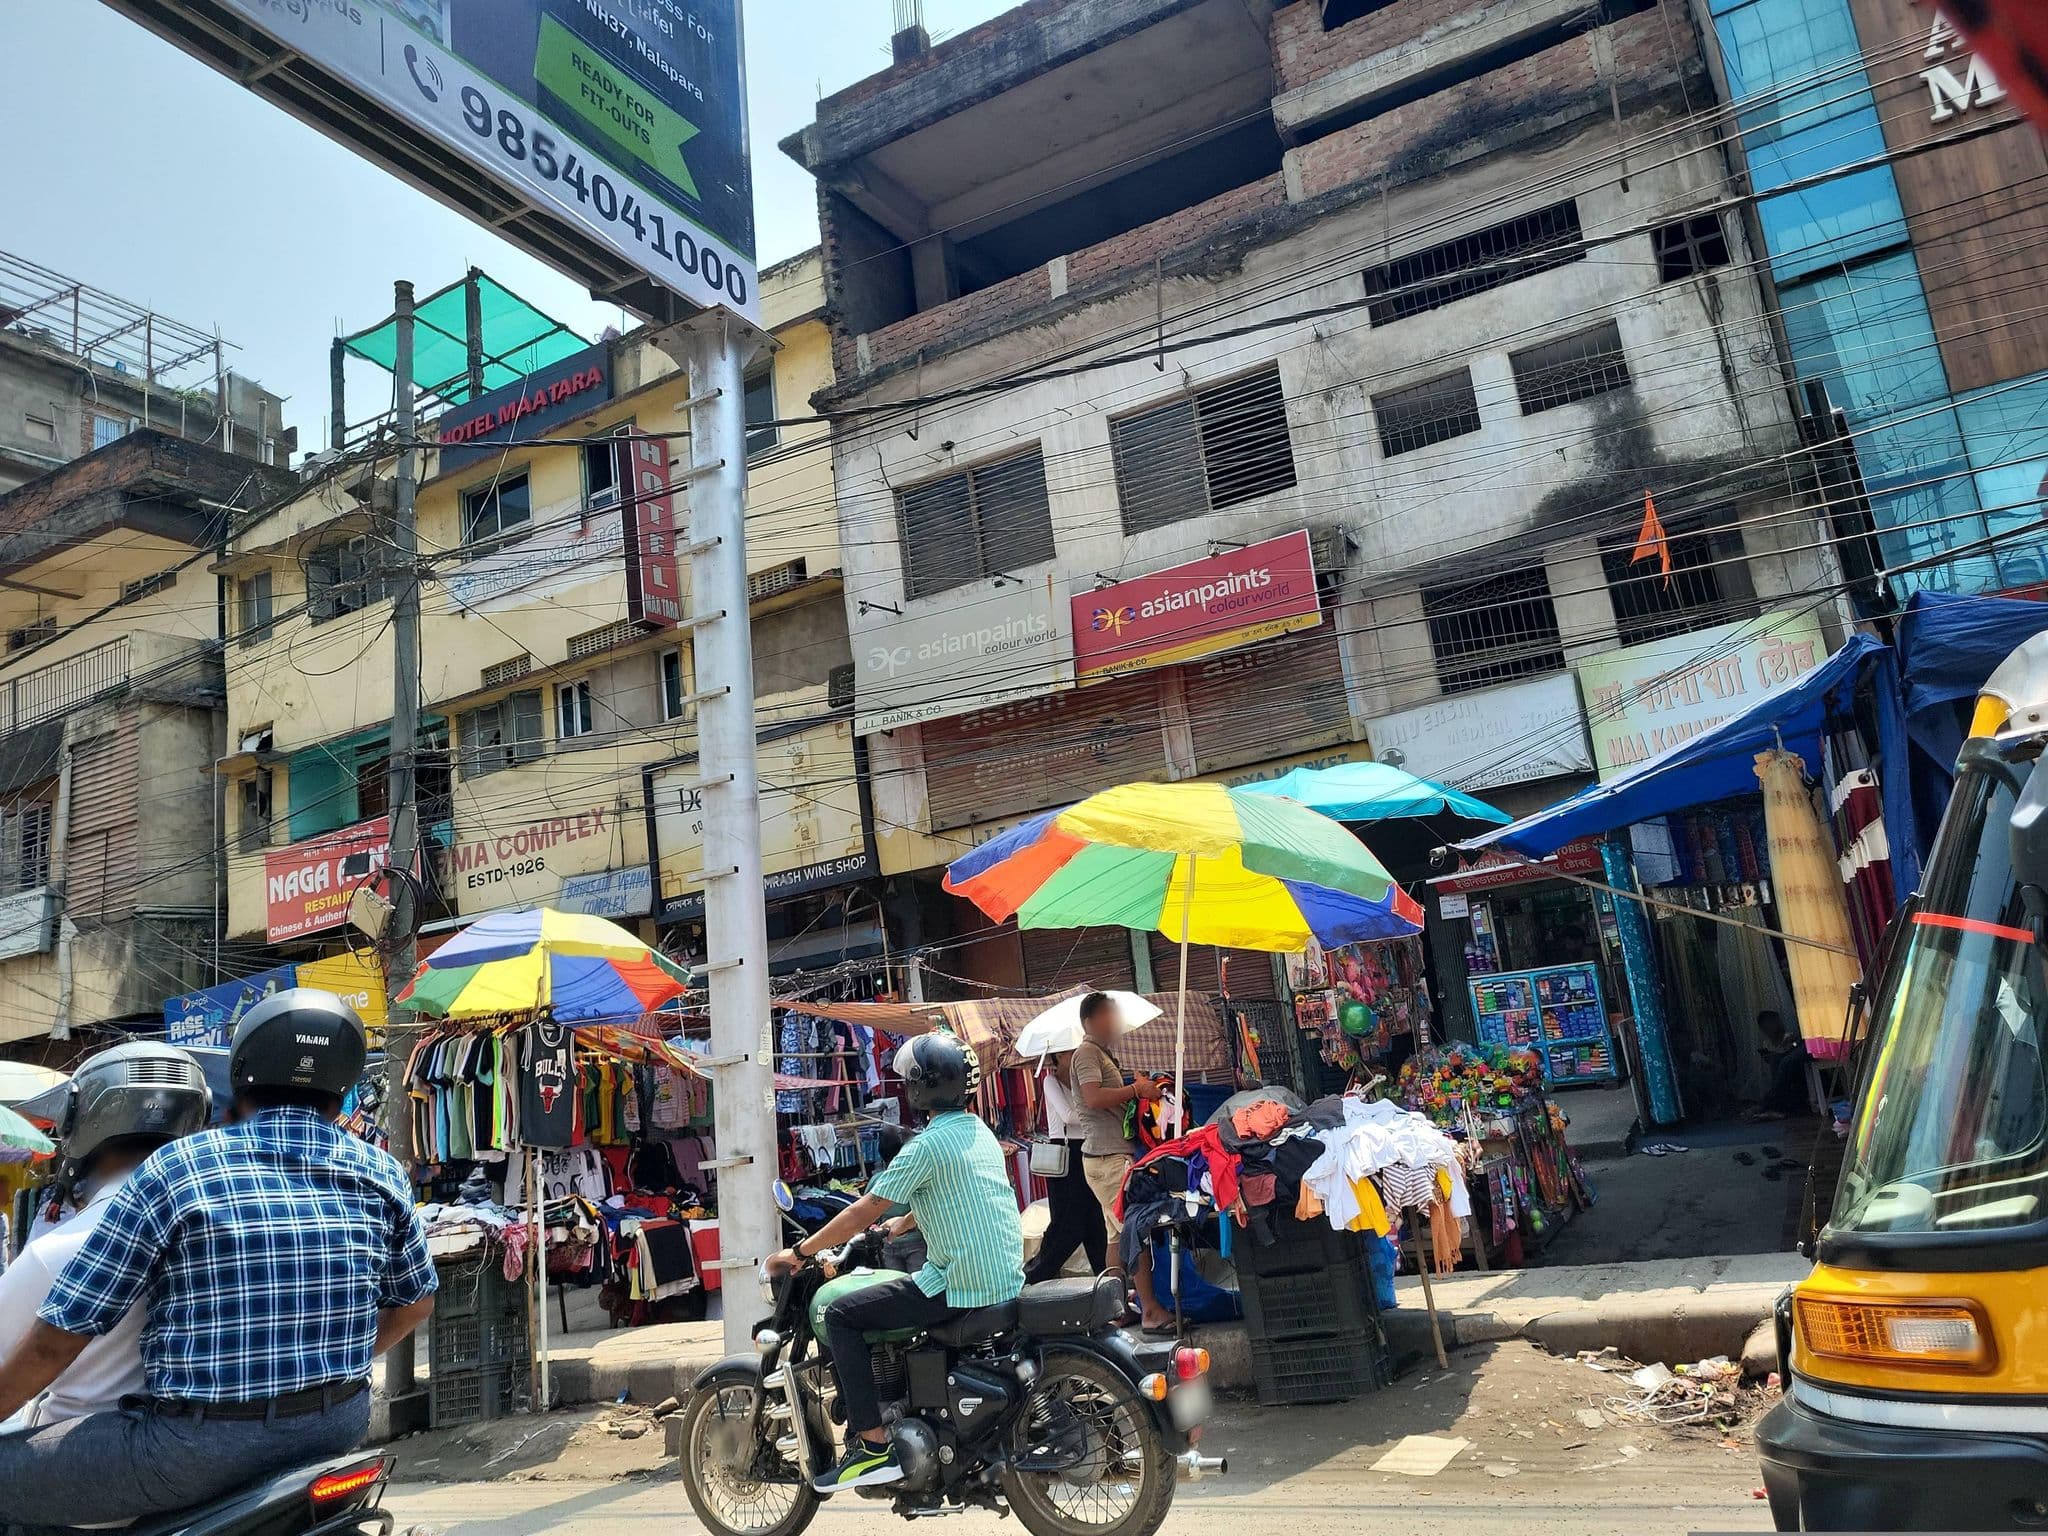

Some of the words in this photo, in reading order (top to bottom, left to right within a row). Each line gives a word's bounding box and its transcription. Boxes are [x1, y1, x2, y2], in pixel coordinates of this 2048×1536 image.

[635, 35, 704, 102] Nalapara
[571, 51, 623, 100] READY
[625, 94, 655, 127] FOR
[580, 83, 651, 145] FIT-OUTS
[459, 85, 748, 307] 9854041000
[439, 413, 496, 444] HOTEL
[498, 393, 549, 426] MAA
[548, 366, 604, 400] TARA
[639, 440, 670, 590] HOTEL
[661, 598, 681, 622] TARA
[1140, 566, 1272, 618] asianpaints
[917, 611, 1049, 661] asianpaints
[984, 637, 1022, 656] colour
[1024, 627, 1058, 646] world
[881, 711, 914, 727] BANIK
[1606, 733, 1651, 769] MAA
[496, 805, 607, 862] COMPLEX
[269, 860, 331, 905] NAGA
[467, 856, 546, 889] ESTD-1926
[803, 862, 835, 882] WINE
[835, 854, 868, 874] SHOP
[269, 920, 303, 938] Chinese
[304, 917, 313, 928] &
[170, 1015, 205, 1041] RISE
[295, 1033, 330, 1046] YAMAHA
[534, 1058, 567, 1081] BULLS
